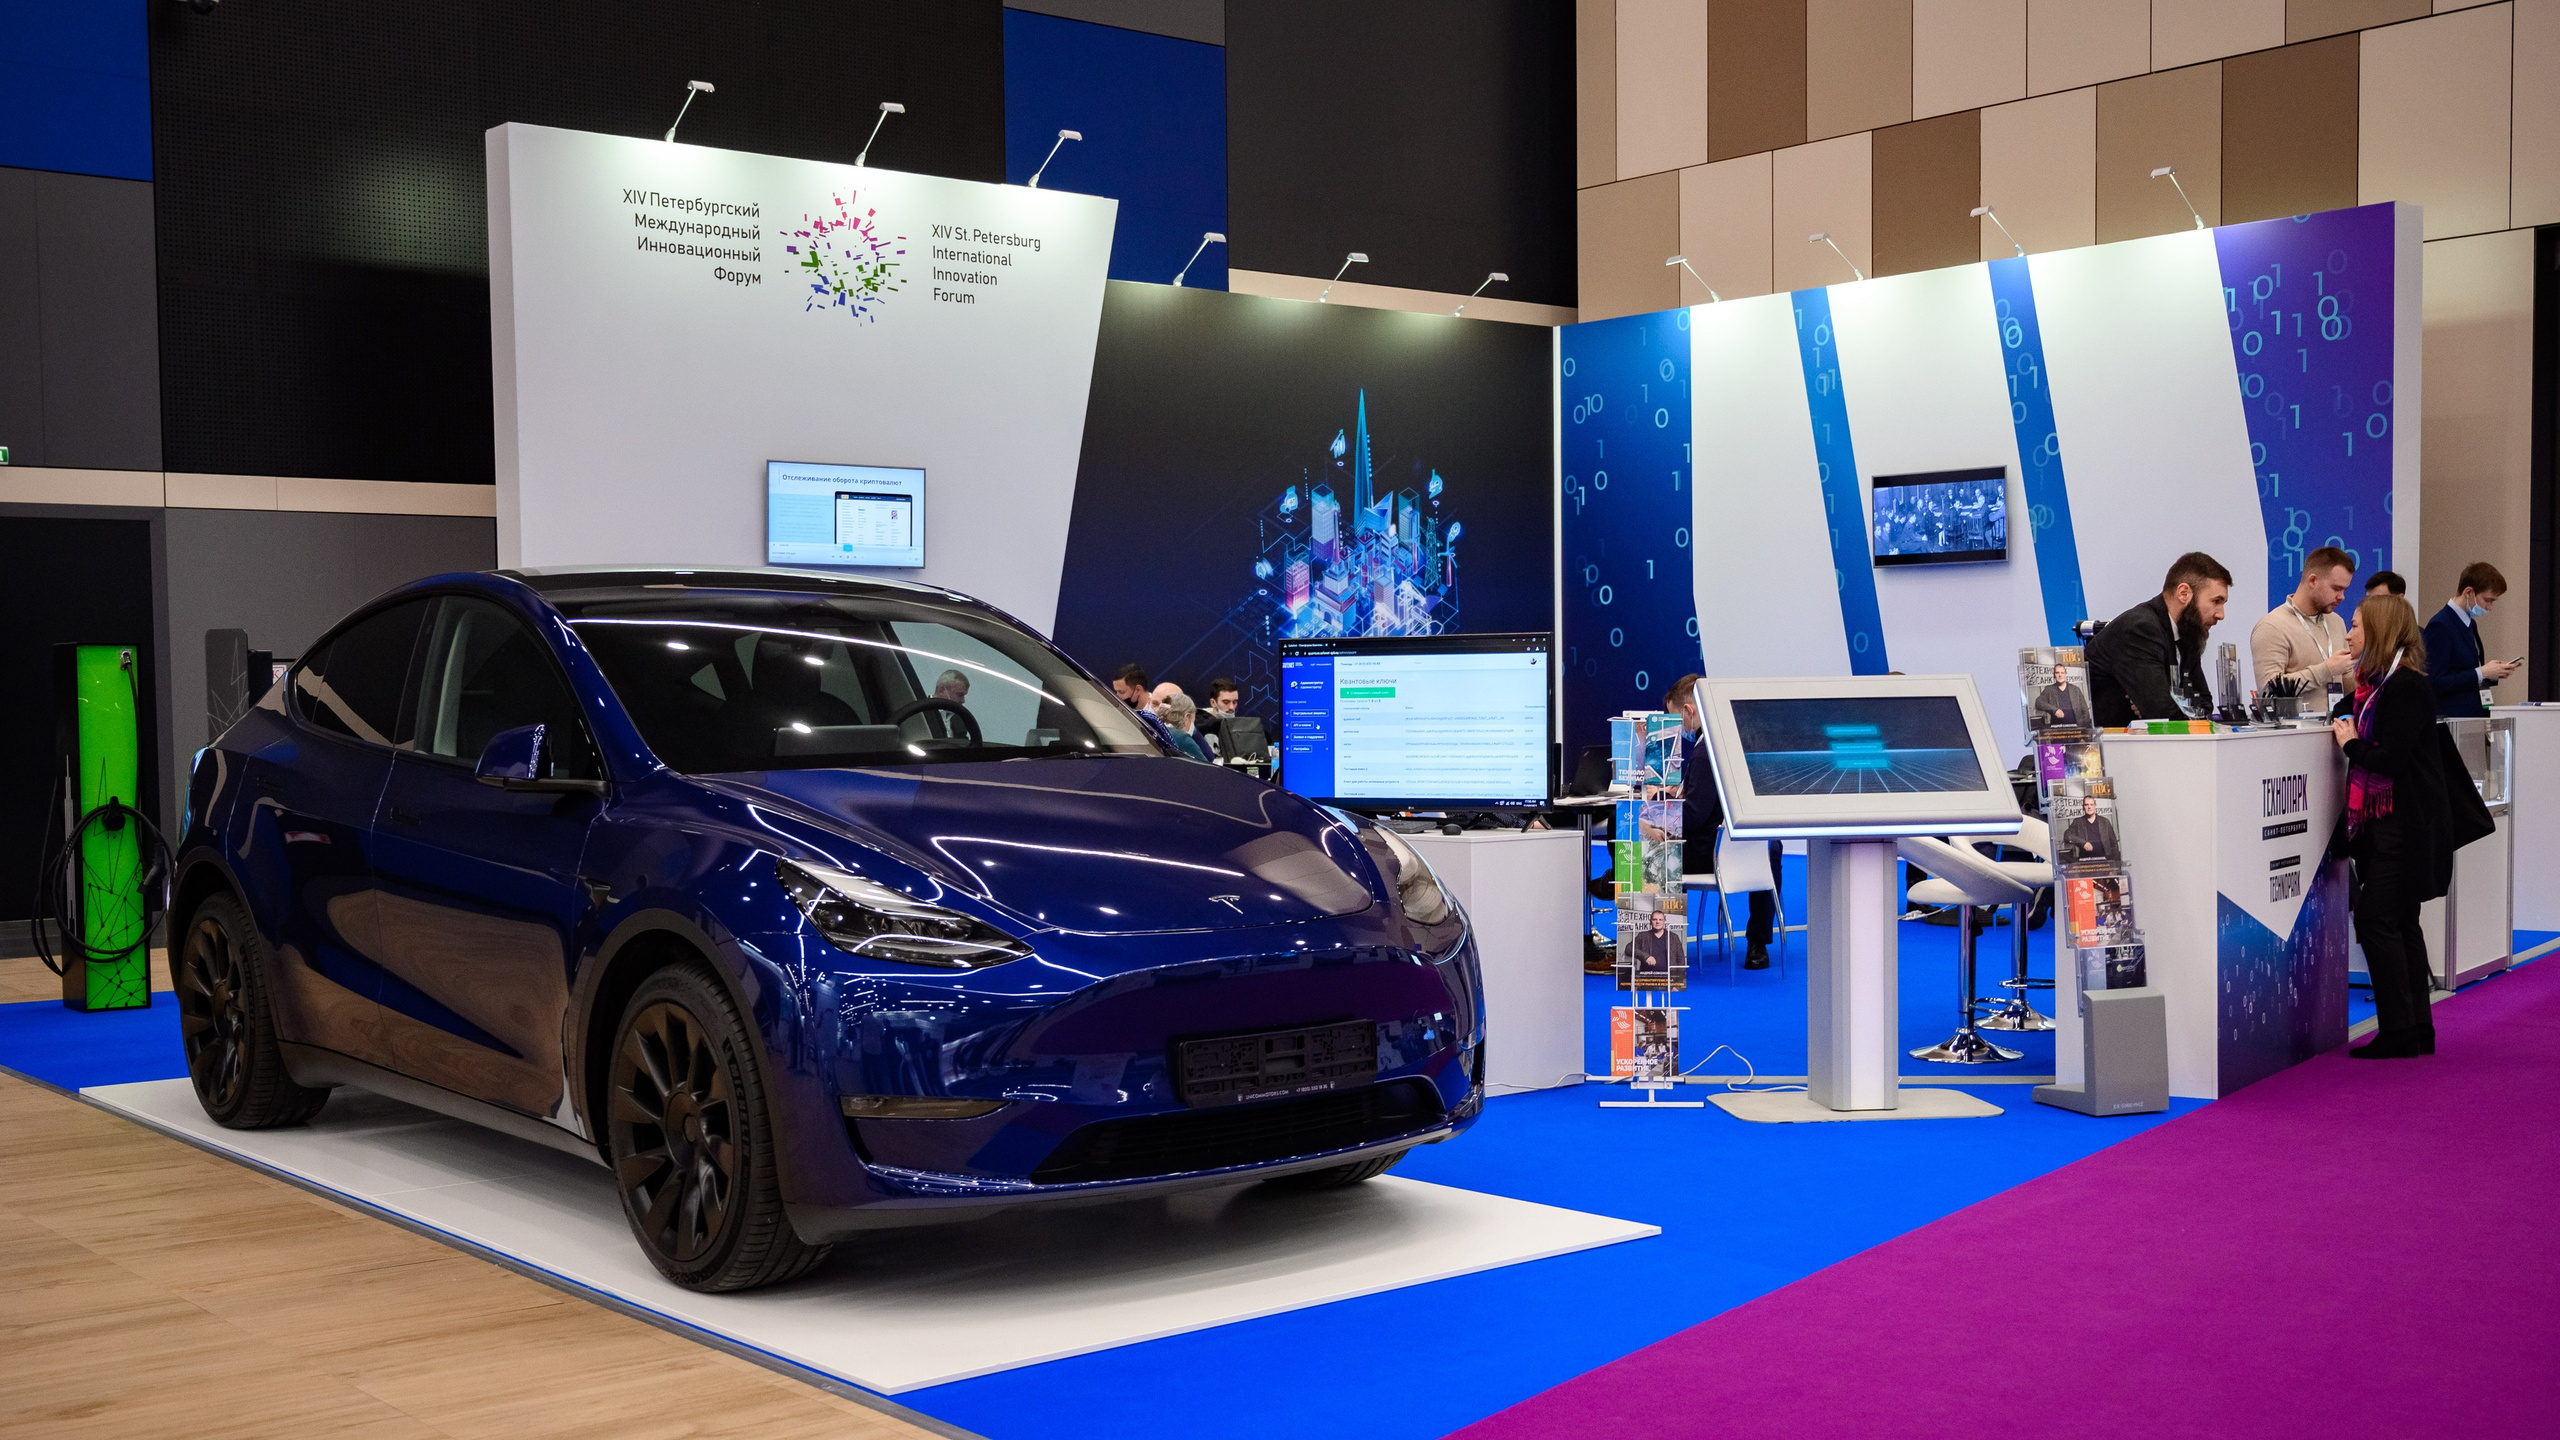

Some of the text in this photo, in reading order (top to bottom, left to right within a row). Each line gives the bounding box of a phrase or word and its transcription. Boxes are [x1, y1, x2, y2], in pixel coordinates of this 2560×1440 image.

[622, 188, 760, 218] XIV Петербургский
[635, 213, 760, 240] Международный
[932, 224, 1041, 252] XIV St. Petersburg
[638, 236, 760, 262] Инновационный
[933, 246, 1012, 266] International
[714, 266, 762, 287] Форум
[934, 266, 998, 286] Innovation
[934, 288, 975, 304] Forum
[782, 474, 902, 486] Отслеживание оборота криптовалют
[2092, 784, 2111, 794] RBG
[2262, 774, 2308, 817] ТЕХНОПАРК
[2264, 822, 2306, 838] САНКТ-ПЕТЕРБУРГА
[2270, 871, 2301, 903] TECHNOPARK
[728, 1062, 750, 1161] MICHELIN
